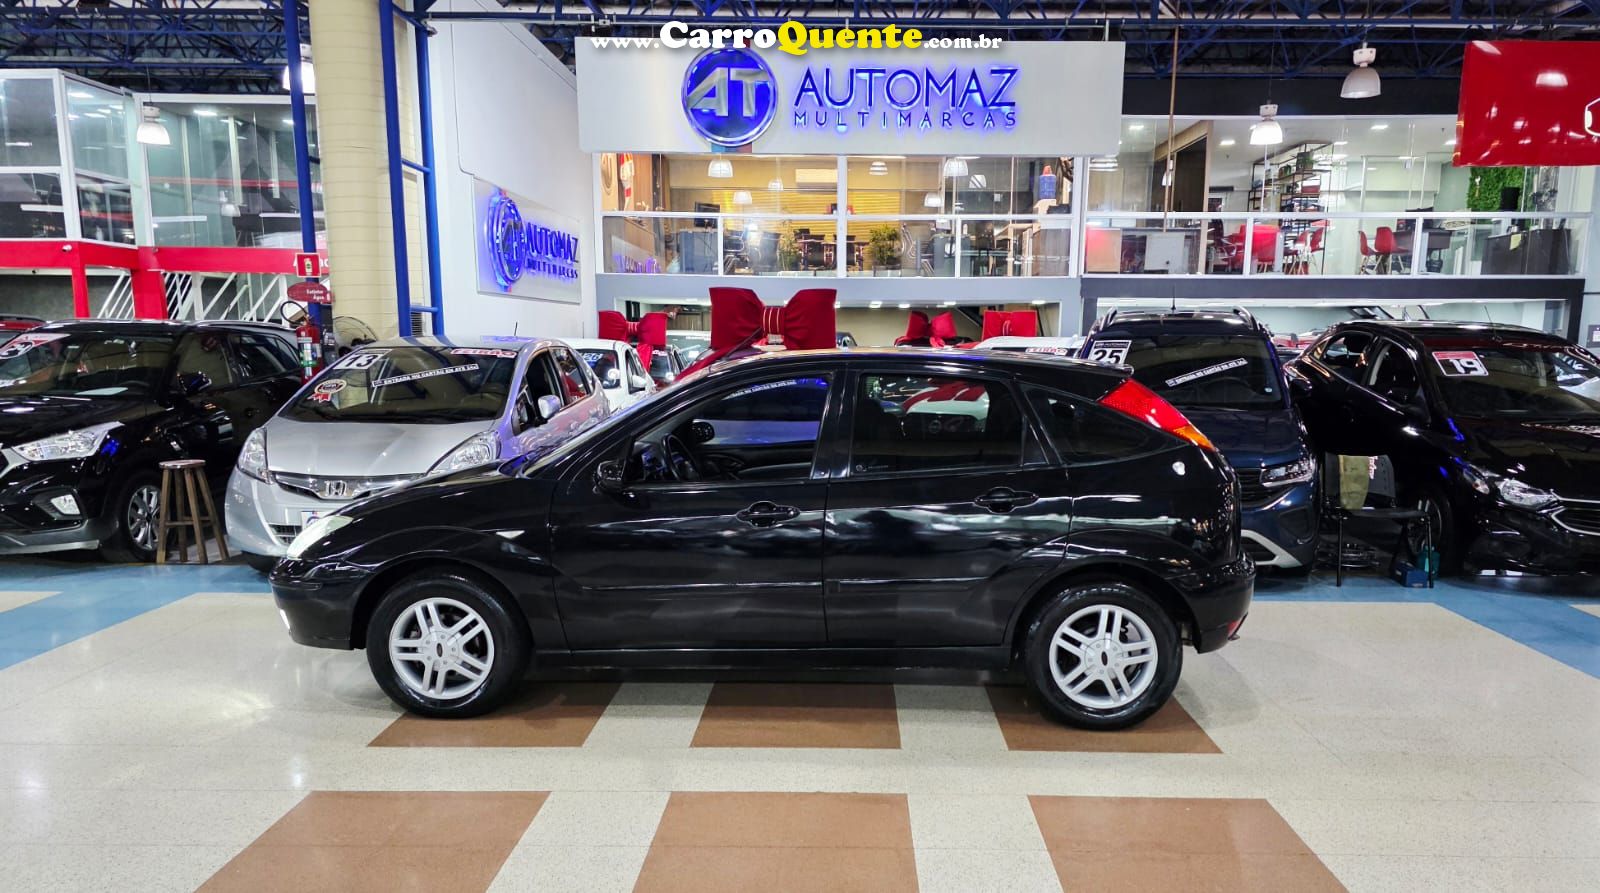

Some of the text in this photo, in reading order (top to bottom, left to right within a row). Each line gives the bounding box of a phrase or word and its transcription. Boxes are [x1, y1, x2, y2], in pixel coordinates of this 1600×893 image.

[686, 67, 769, 117] AT
[794, 68, 1018, 107] AUTOMAZ
[794, 112, 1016, 127] MULTIMARCAS
[525, 221, 579, 263] AUTOMAZ
[345, 354, 378, 367] 13
[1094, 349, 1123, 364] 25
[1449, 359, 1485, 375] 19
